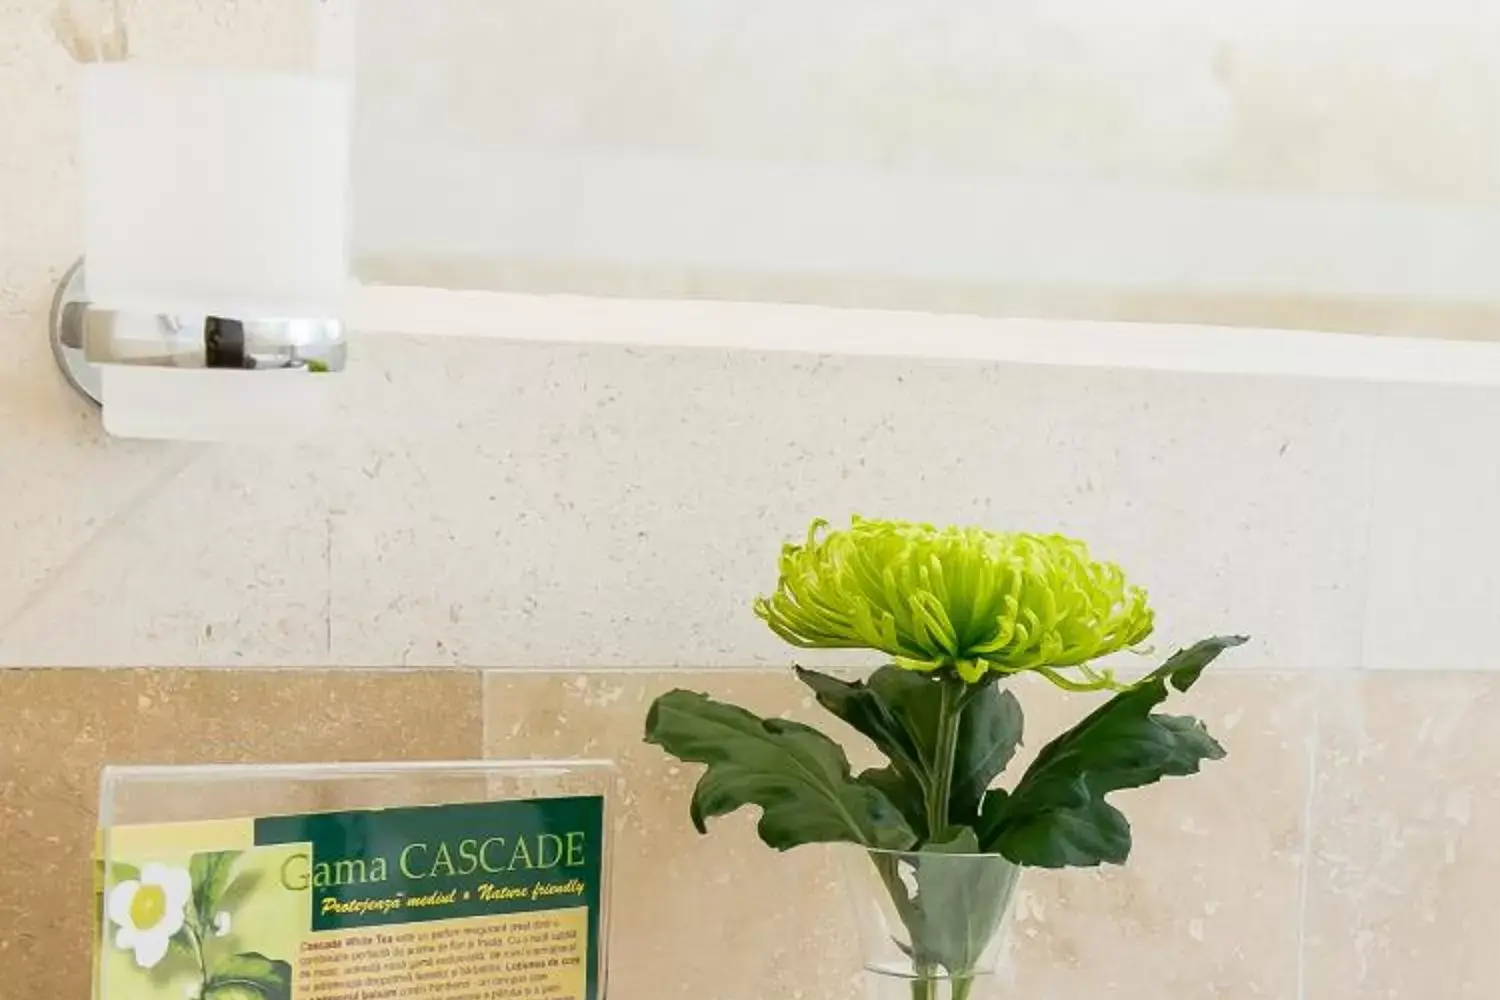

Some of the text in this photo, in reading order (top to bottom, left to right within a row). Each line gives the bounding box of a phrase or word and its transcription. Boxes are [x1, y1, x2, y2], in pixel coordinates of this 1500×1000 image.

[280, 831, 586, 891] Gama CASCADE
[477, 881, 528, 902] Nature
[530, 879, 586, 902] friendly
[300, 937, 342, 952] Cascade
[344, 933, 372, 947] White
[375, 931, 393, 944] Tea
